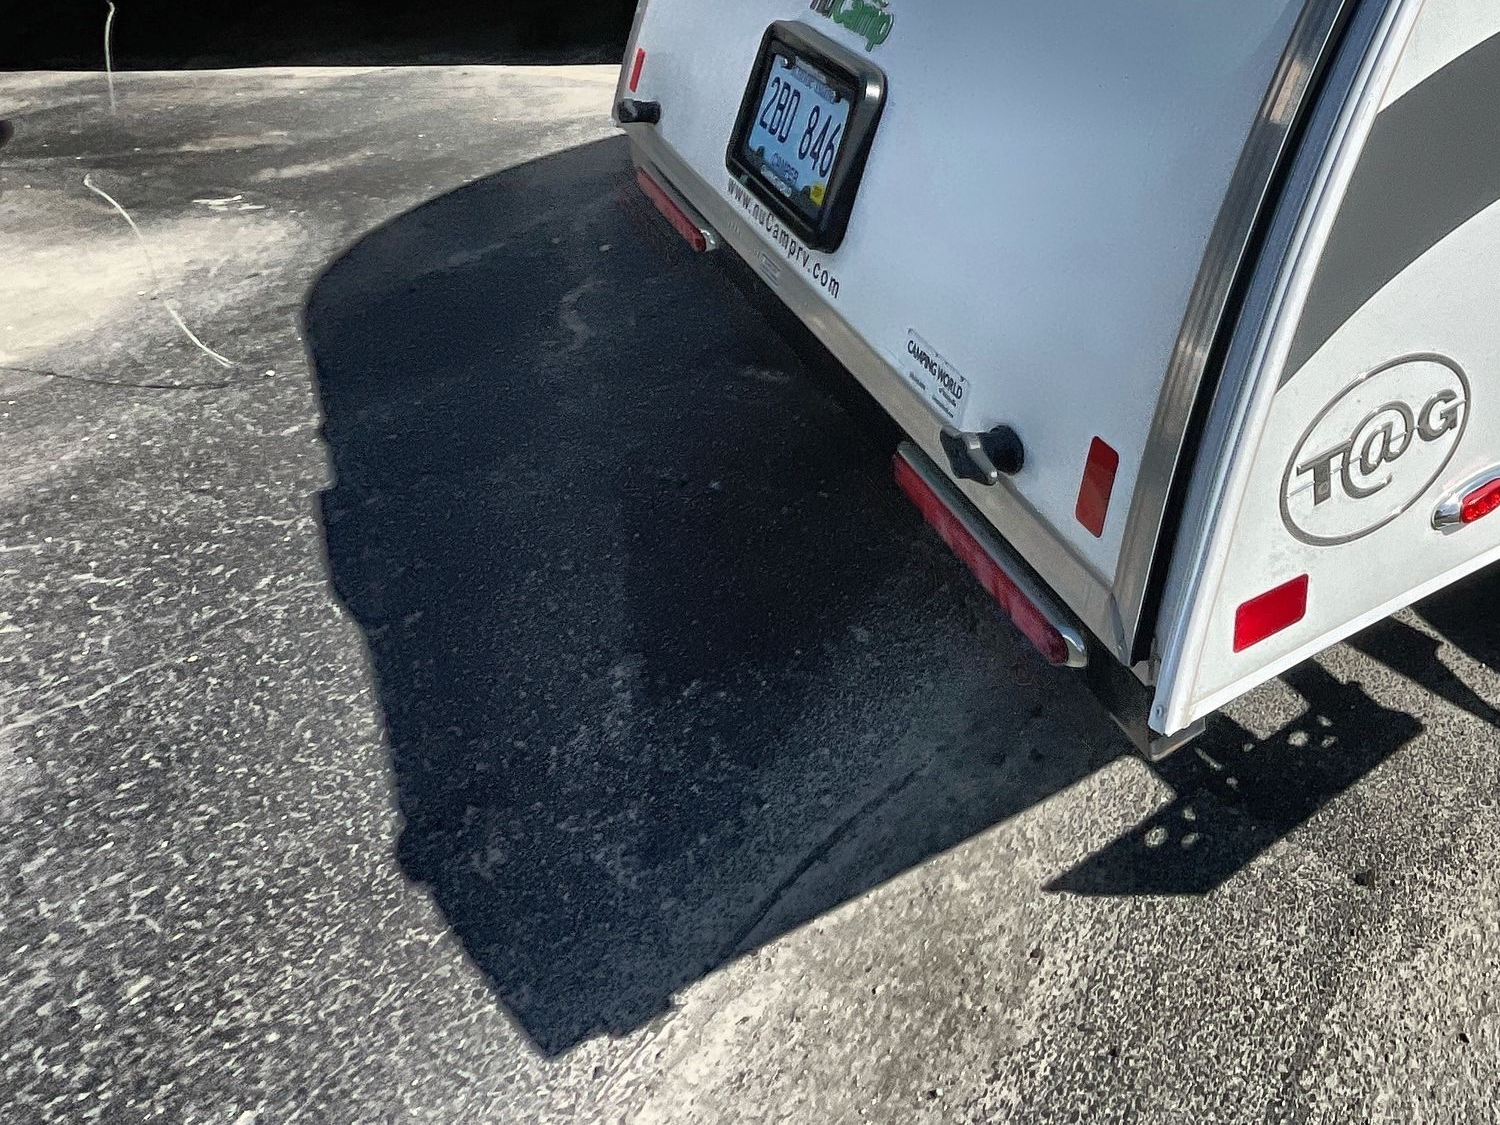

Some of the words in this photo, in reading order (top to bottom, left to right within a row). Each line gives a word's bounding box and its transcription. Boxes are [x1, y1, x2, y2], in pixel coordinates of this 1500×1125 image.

[759, 76, 800, 143] 2BD
[798, 105, 842, 178] 846
[728, 177, 840, 299] www.nuCamprv.com
[907, 339, 938, 376] CAMPING
[936, 365, 963, 400] WORLD
[1296, 389, 1459, 507] T@G
